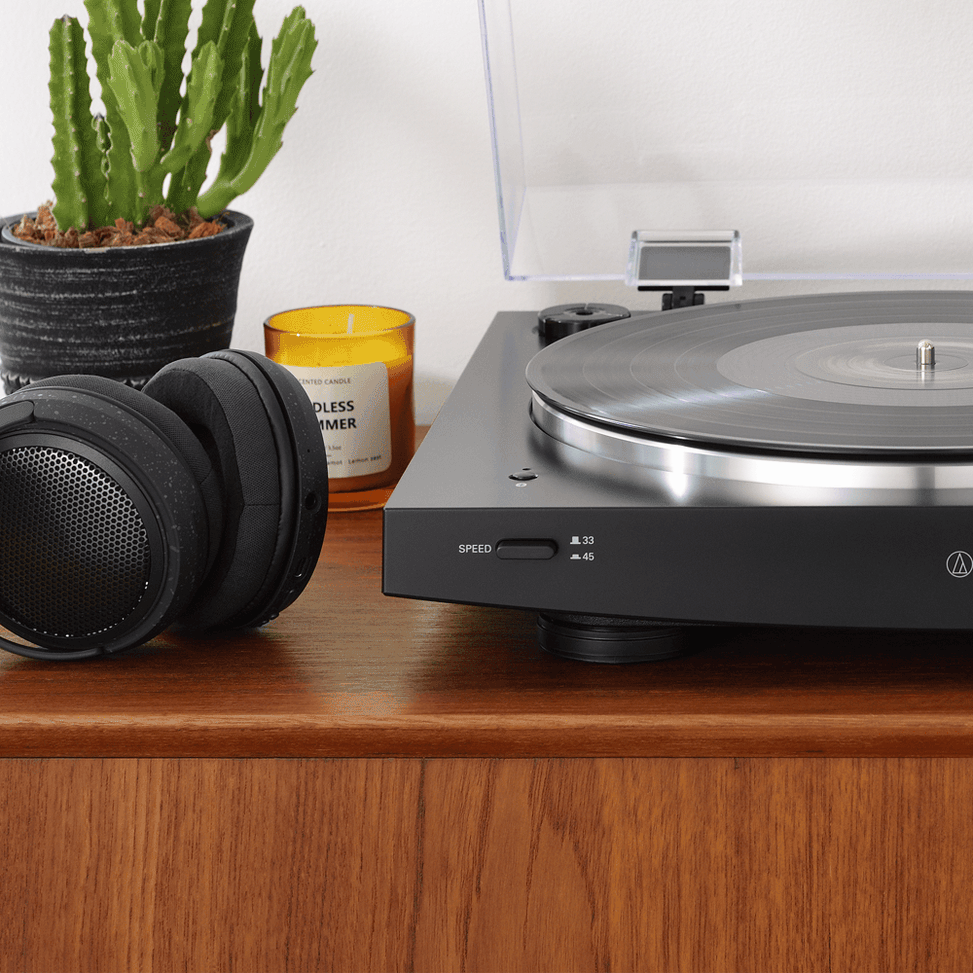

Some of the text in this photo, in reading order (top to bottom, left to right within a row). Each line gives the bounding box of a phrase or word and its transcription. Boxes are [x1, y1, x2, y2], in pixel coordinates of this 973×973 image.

[313, 400, 355, 413] DLESS
[319, 418, 357, 430] MMER
[582, 536, 595, 545] 33
[458, 544, 492, 553] SPEED
[582, 552, 595, 561] 45
